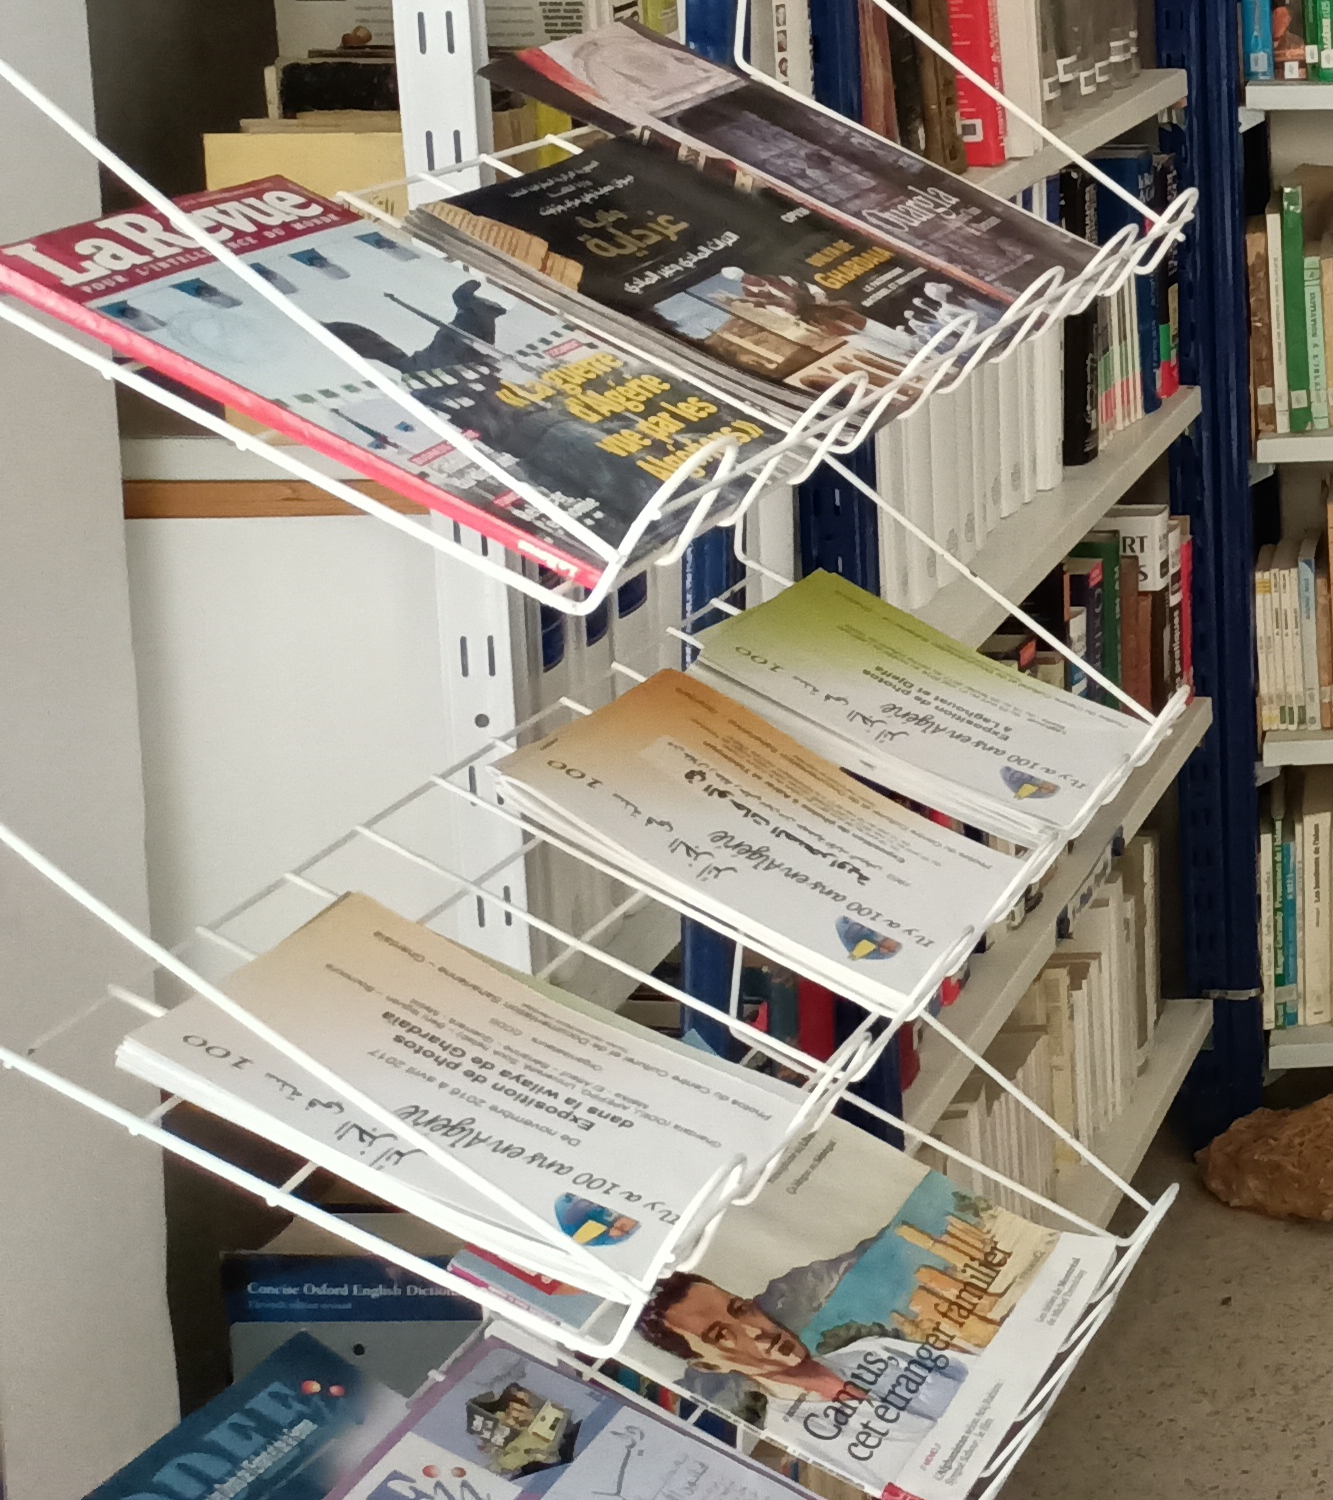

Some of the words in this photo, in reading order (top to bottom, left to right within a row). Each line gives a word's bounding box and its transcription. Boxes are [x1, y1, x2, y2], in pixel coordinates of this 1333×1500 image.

[862, 184, 961, 232] Ouargla
[80, 275, 130, 294] POUR
[264, 227, 286, 240] DU
[290, 212, 342, 232] MONDE
[541, 351, 623, 396] guerre
[564, 373, 671, 424] d'Algérie
[661, 397, 718, 423] les
[638, 408, 685, 444] par
[595, 428, 652, 457] vue
[735, 647, 784, 672] 100
[863, 669, 913, 695] photos
[917, 688, 931, 696] et
[914, 696, 931, 705] de
[934, 696, 1000, 728] Laghouat
[880, 703, 948, 734] Algérie
[935, 700, 1011, 741] Exposition
[946, 730, 972, 743] en
[971, 740, 1006, 755] ans
[547, 760, 602, 788] 100
[1007, 755, 1039, 769] 100
[709, 831, 784, 871] Algérie
[781, 867, 809, 883] en
[810, 882, 847, 901] ans
[846, 902, 883, 921] 100
[382, 1011, 466, 1065] Ghardaïa
[393, 1031, 462, 1070] photos
[183, 1035, 253, 1069] 100
[367, 1050, 406, 1068] 2017
[471, 1056, 495, 1070] de
[405, 1067, 437, 1082] avril
[463, 1070, 487, 1084] de
[499, 1070, 559, 1099] wilaya
[449, 1088, 486, 1107] 2016
[491, 1074, 595, 1131] Exposition
[564, 1097, 581, 1110] la
[391, 1105, 492, 1148] Algérie
[489, 1105, 555, 1136] novembre
[587, 1107, 634, 1128] dans
[491, 1140, 525, 1158] en
[560, 1134, 581, 1147] De
[525, 1153, 573, 1175] ans
[573, 1173, 620, 1195] 100
[623, 1191, 642, 1202] a
[645, 1202, 665, 1213] y
[246, 1280, 300, 1297] Concise
[302, 1280, 349, 1298] Oxford
[352, 1280, 402, 1299] English
[932, 1232, 1016, 1330] familier
[863, 1313, 965, 1433] étranger
[803, 1349, 900, 1441] Camus,
[844, 1418, 889, 1466] cet
